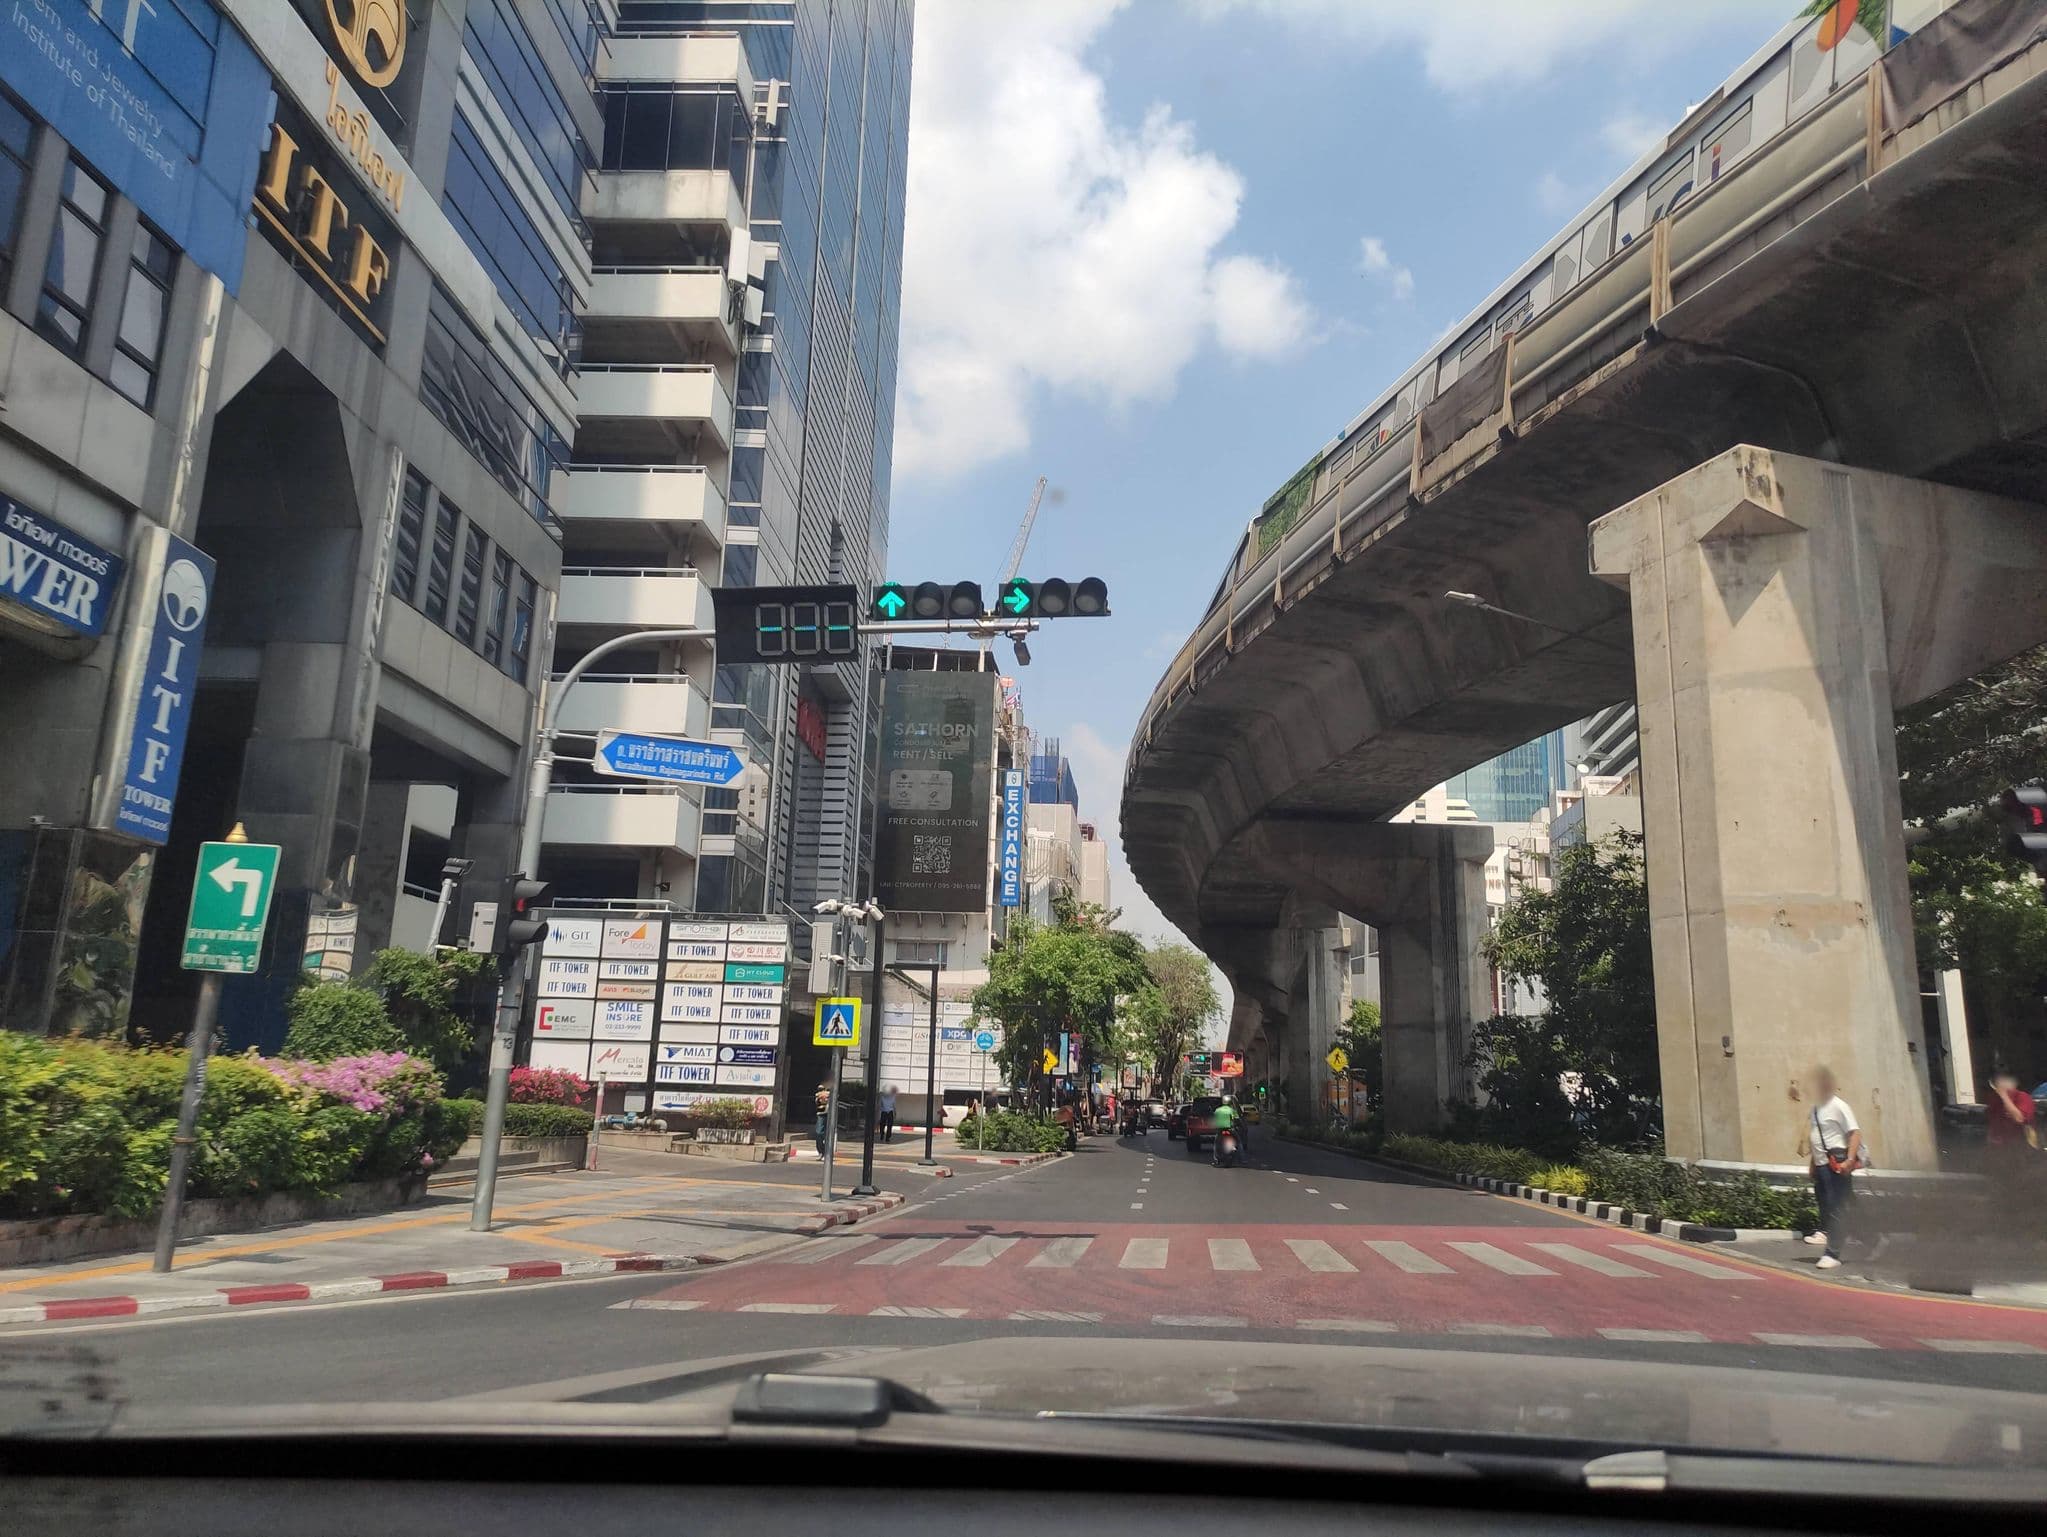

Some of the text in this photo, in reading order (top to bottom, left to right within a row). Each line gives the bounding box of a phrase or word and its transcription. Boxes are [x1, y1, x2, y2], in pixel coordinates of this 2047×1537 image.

[65, 27, 98, 70] and
[102, 63, 164, 139] Jewelry
[12, 2, 176, 181] Institute of Thailand
[254, 122, 391, 305] ITF
[893, 722, 979, 738] SATHORN
[893, 750, 921, 760] RENT
[929, 751, 954, 760] SELL
[123, 784, 172, 814] TOWER
[888, 817, 979, 828] FREE CONSULTATION
[1003, 788, 1021, 896] EXCHANGE
[571, 930, 591, 940] GIT
[608, 928, 630, 938] Fore
[677, 944, 717, 956] ITF TOWER
[549, 962, 589, 974] ITF TOWER
[609, 963, 649, 976] ITF TOWER
[547, 981, 587, 993] ITF TOWER
[673, 986, 713, 998] ITF TOWER
[733, 987, 773, 999] ITF TOWER
[607, 1001, 643, 1013] SMILE
[671, 1005, 711, 1017] ITF TOWER
[554, 1015, 577, 1024] EMC
[731, 1008, 771, 1020] ITF TOWER
[729, 1028, 769, 1041] ITF TOWER
[683, 1046, 713, 1058] MIAT
[659, 1065, 674, 1080] ITF
[678, 1066, 711, 1081] TOWER
